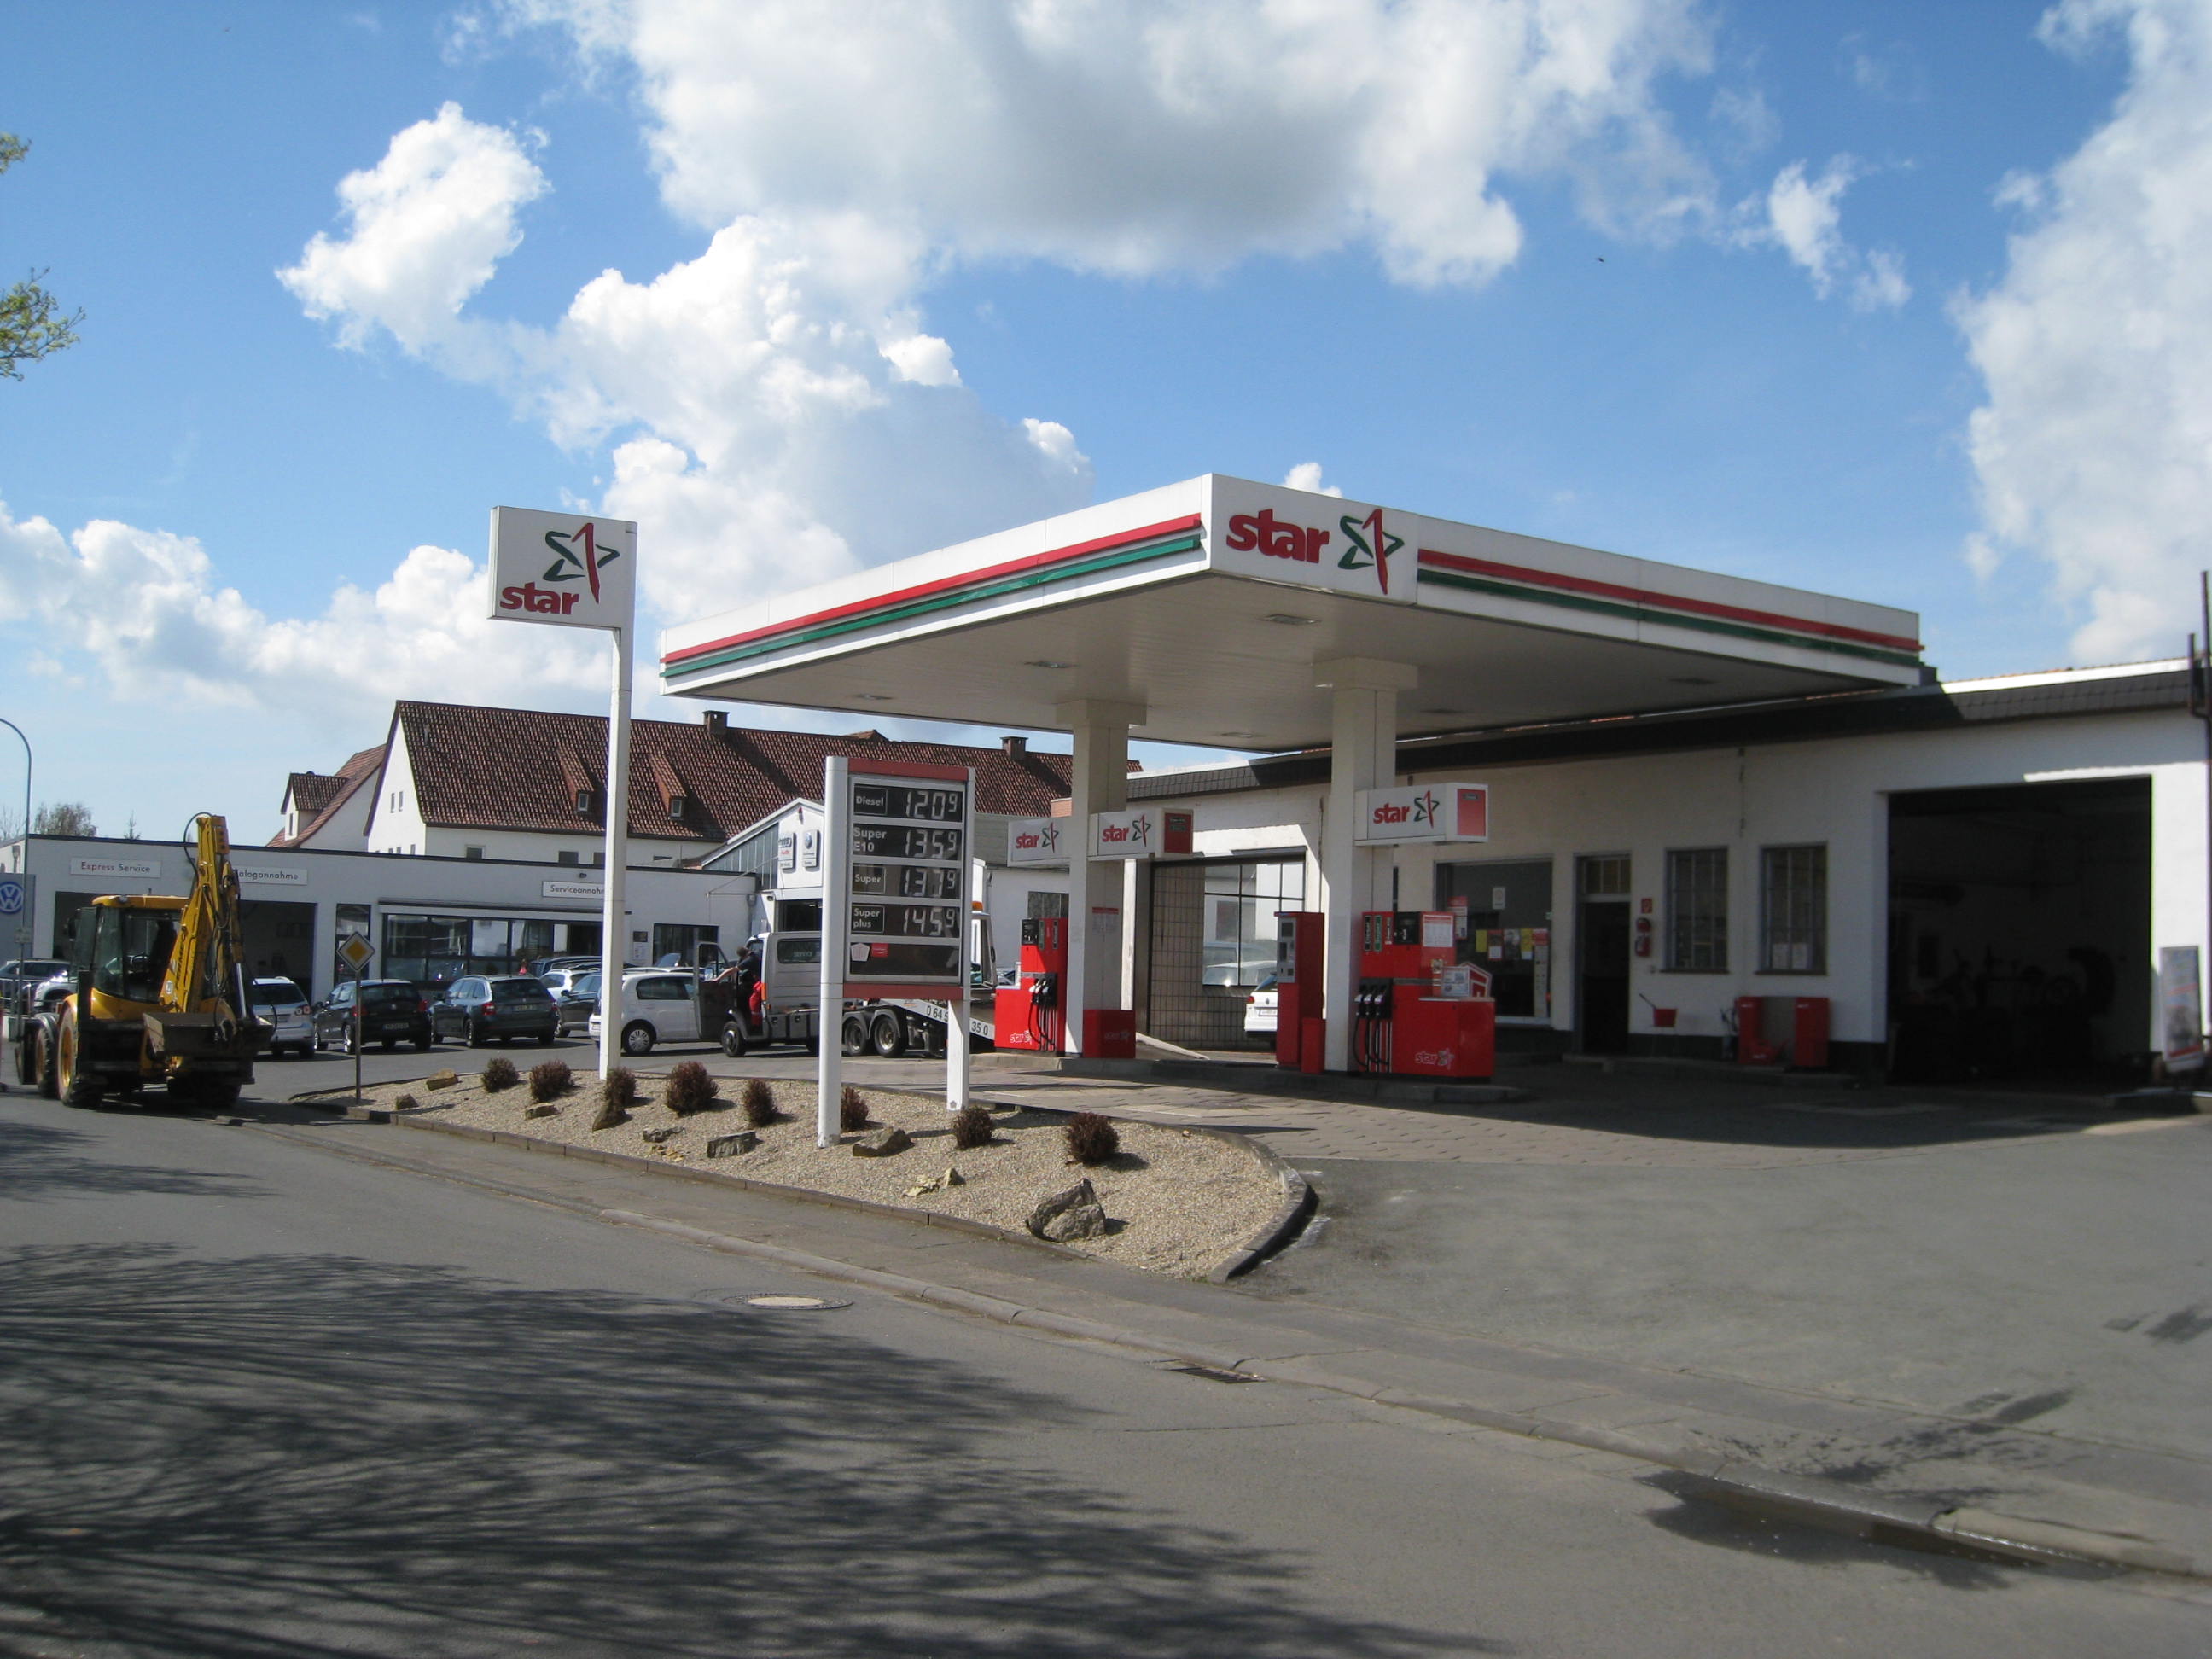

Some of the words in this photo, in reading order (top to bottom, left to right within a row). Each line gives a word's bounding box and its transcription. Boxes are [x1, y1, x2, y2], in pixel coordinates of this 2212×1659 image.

[1226, 509, 1330, 563] star
[499, 581, 579, 614] star
[856, 795, 884, 806] Diesel
[1373, 802, 1411, 824] star
[853, 826, 887, 840] Super
[1102, 824, 1130, 842] star
[1016, 832, 1039, 848] star
[853, 841, 875, 853] E10
[81, 862, 114, 872] Express
[119, 863, 151, 873] Service
[238, 869, 299, 880] alogannahme
[854, 873, 882, 884] Super
[550, 884, 604, 895] Serviceannah
[853, 907, 881, 918] Super
[853, 919, 871, 929] plus
